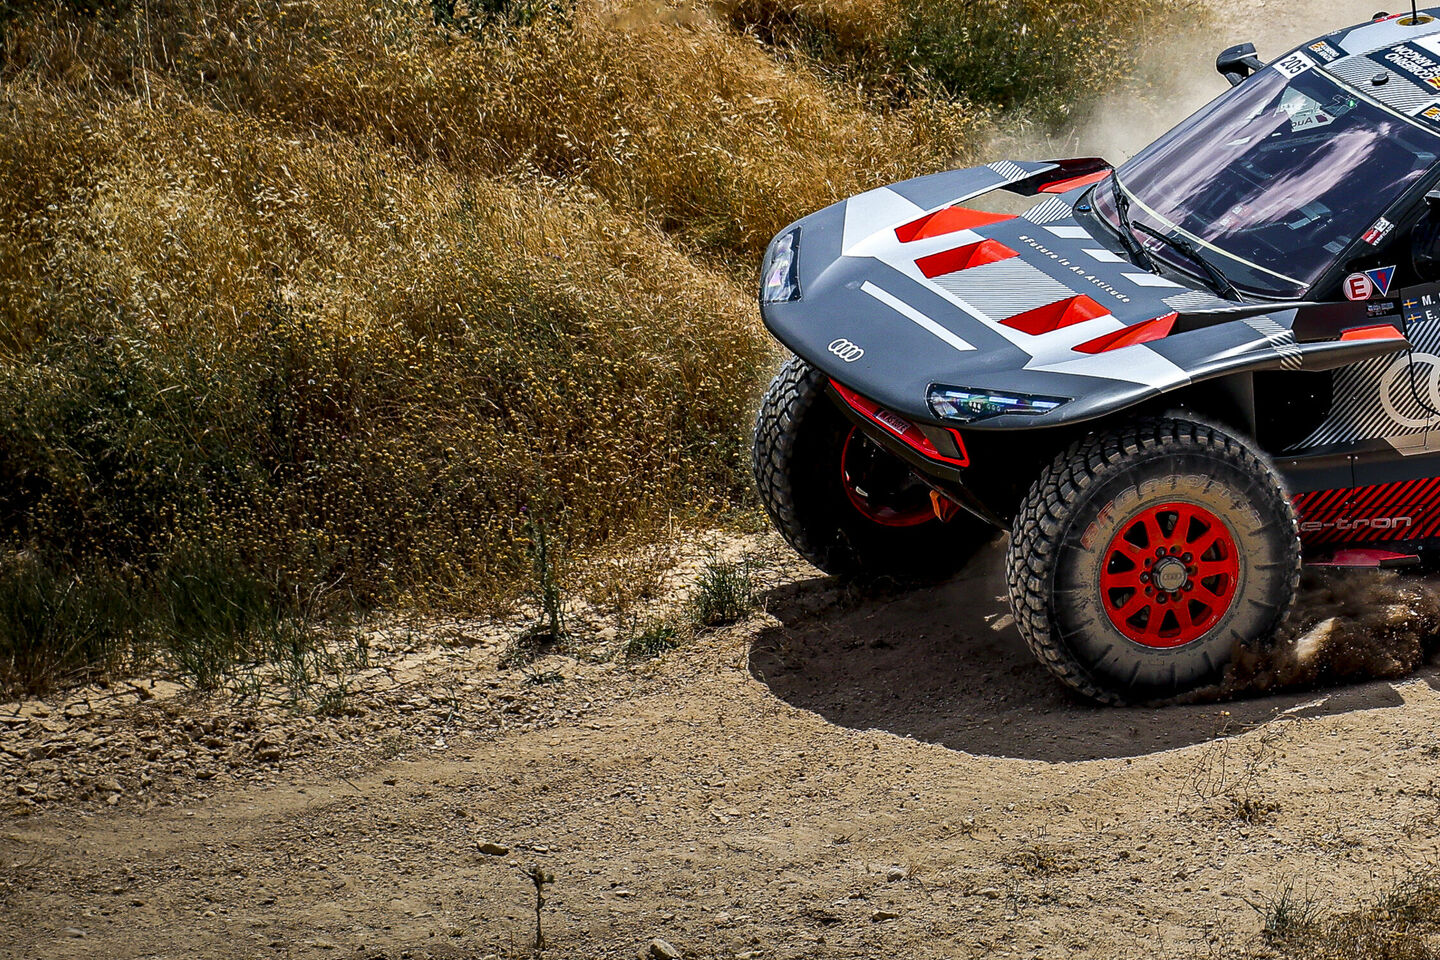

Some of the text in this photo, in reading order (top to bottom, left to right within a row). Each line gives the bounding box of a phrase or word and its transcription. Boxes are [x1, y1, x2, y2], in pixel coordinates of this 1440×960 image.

[1280, 55, 1308, 75] 205
[1384, 52, 1434, 80] GOBIERNO
[1069, 264, 1085, 276] An
[1084, 274, 1131, 304] Attitude
[1349, 277, 1367, 299] E
[1421, 295, 1436, 307] M.
[1425, 310, 1438, 320] E.
[1300, 516, 1412, 532] e-tron
